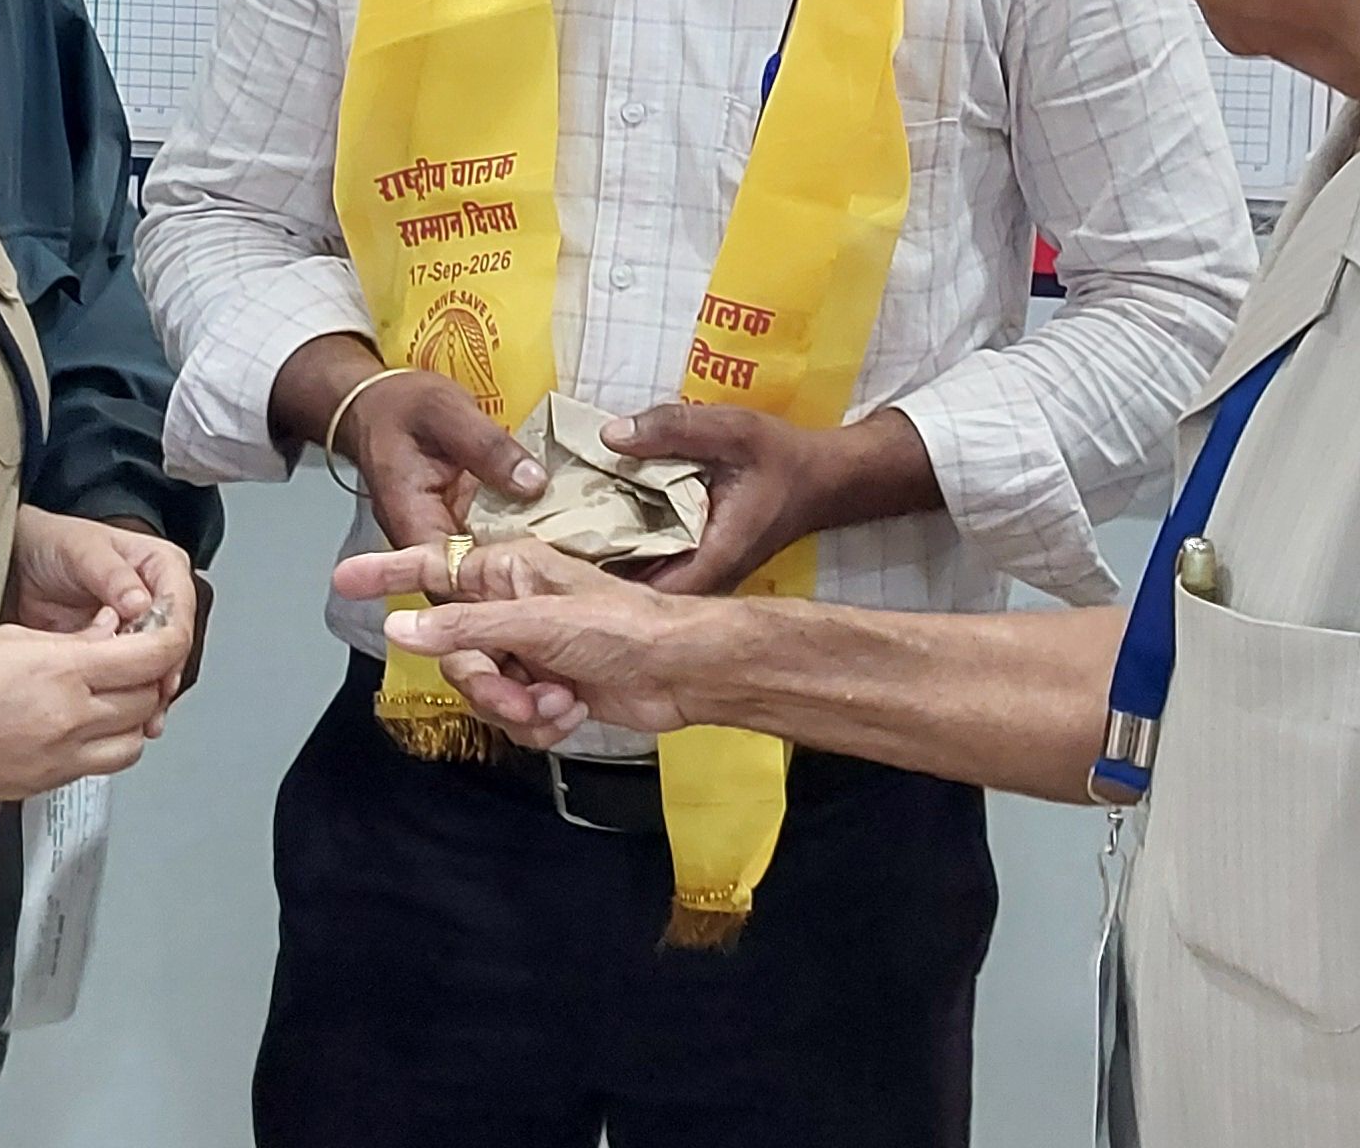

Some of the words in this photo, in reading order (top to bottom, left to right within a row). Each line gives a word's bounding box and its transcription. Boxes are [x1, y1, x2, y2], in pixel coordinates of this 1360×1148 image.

[374, 157, 447, 202] राष्ट्रीय
[451, 152, 518, 188] चालक
[396, 210, 464, 248] सम्मान
[462, 201, 518, 237] दिवस
[409, 250, 512, 287] 17-Sep-2026
